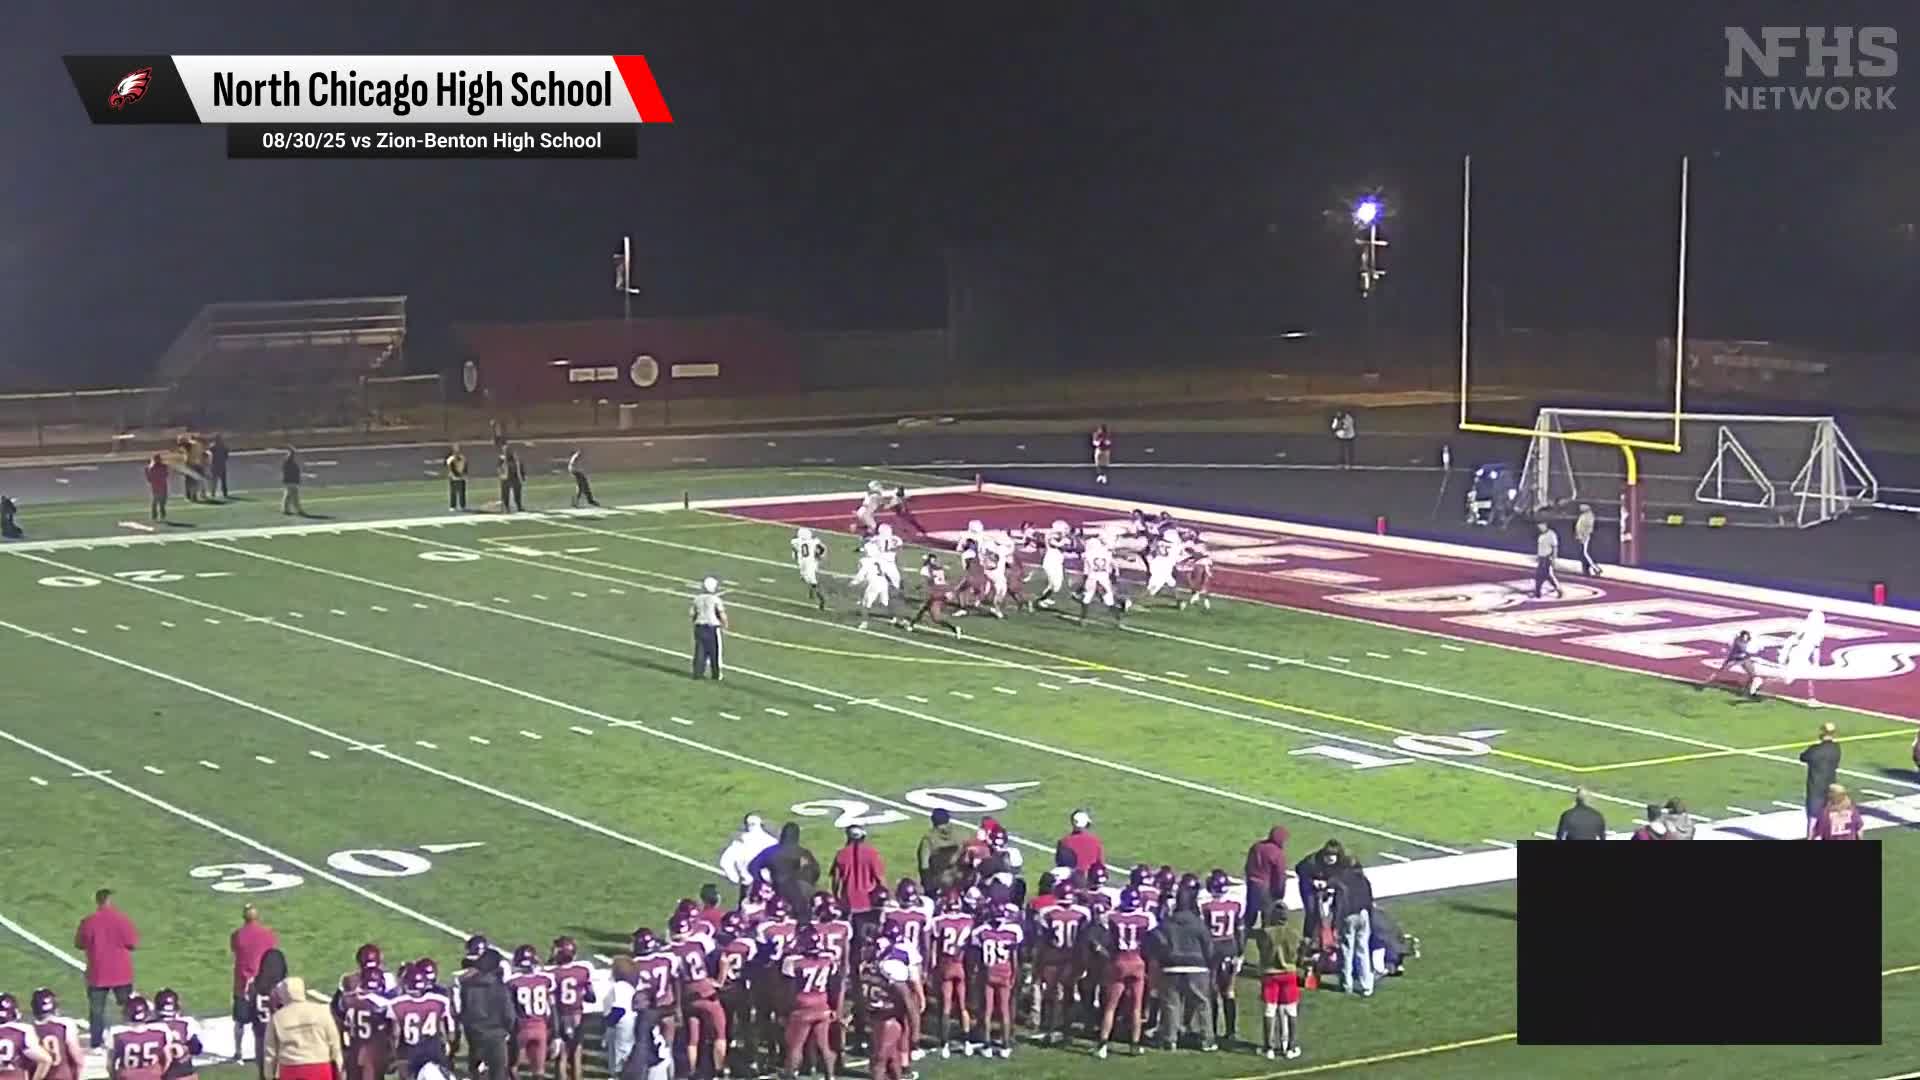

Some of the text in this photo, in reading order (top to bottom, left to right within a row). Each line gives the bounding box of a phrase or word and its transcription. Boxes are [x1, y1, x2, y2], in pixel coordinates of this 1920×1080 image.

[1288, 735, 1492, 769] 10
[791, 788, 1008, 828] 20
[190, 849, 432, 892] 30
[1051, 920, 1076, 947] 30
[1117, 922, 1137, 950] 11
[1210, 911, 1235, 937] 51
[561, 977, 577, 1004] 6
[802, 966, 830, 993] 74
[517, 985, 548, 1016] 98
[404, 1011, 438, 1045] 64
[123, 1042, 160, 1068] 65
